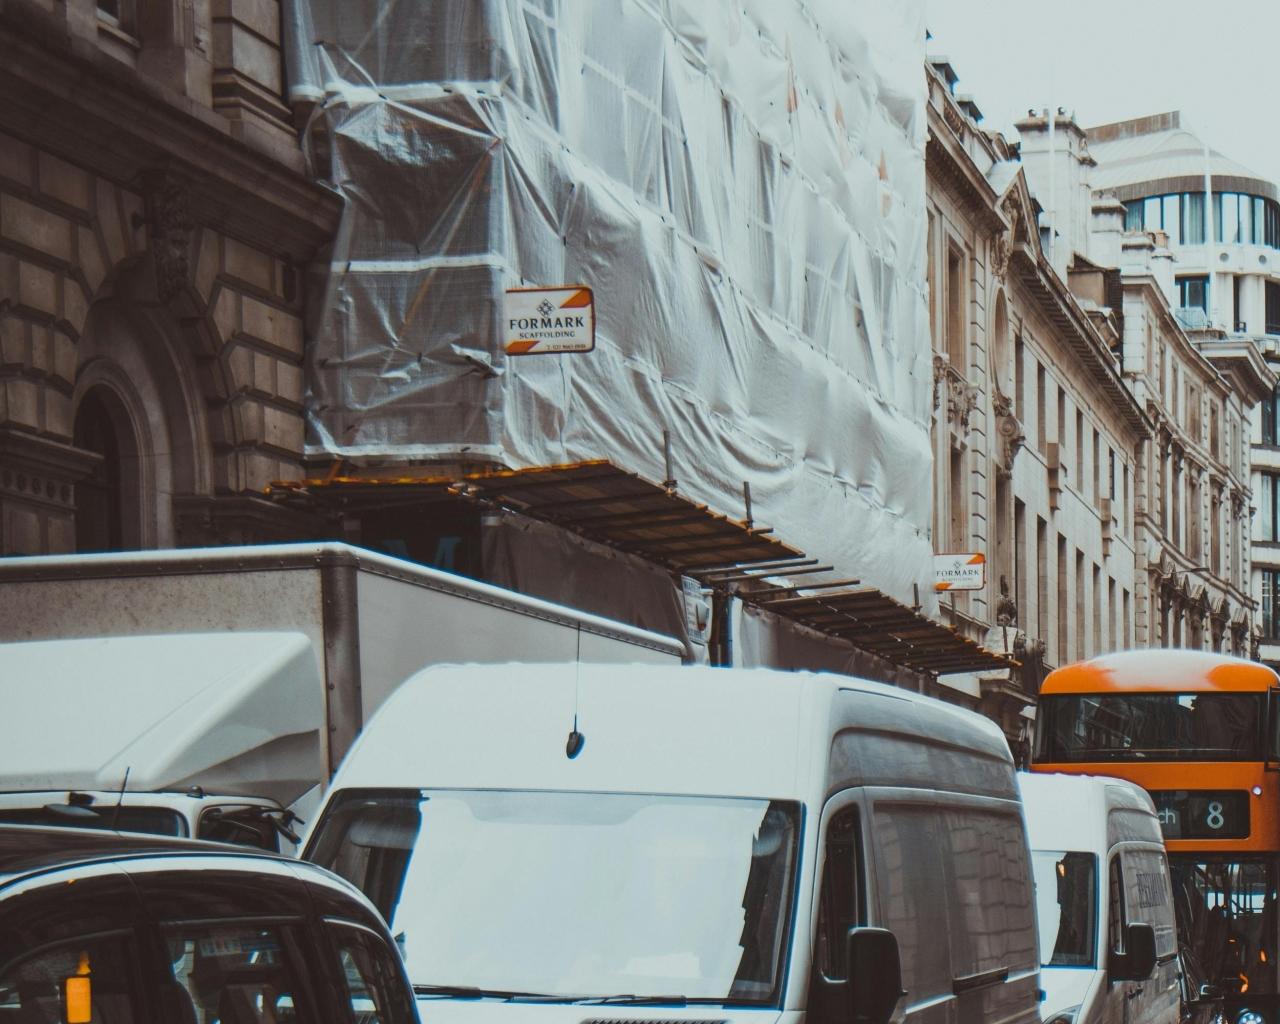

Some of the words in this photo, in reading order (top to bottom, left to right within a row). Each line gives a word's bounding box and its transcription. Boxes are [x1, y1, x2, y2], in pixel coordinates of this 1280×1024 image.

[510, 317, 584, 330] FORMARK
[519, 331, 575, 339] SCAFFOLDING
[1207, 802, 1224, 829] 8
